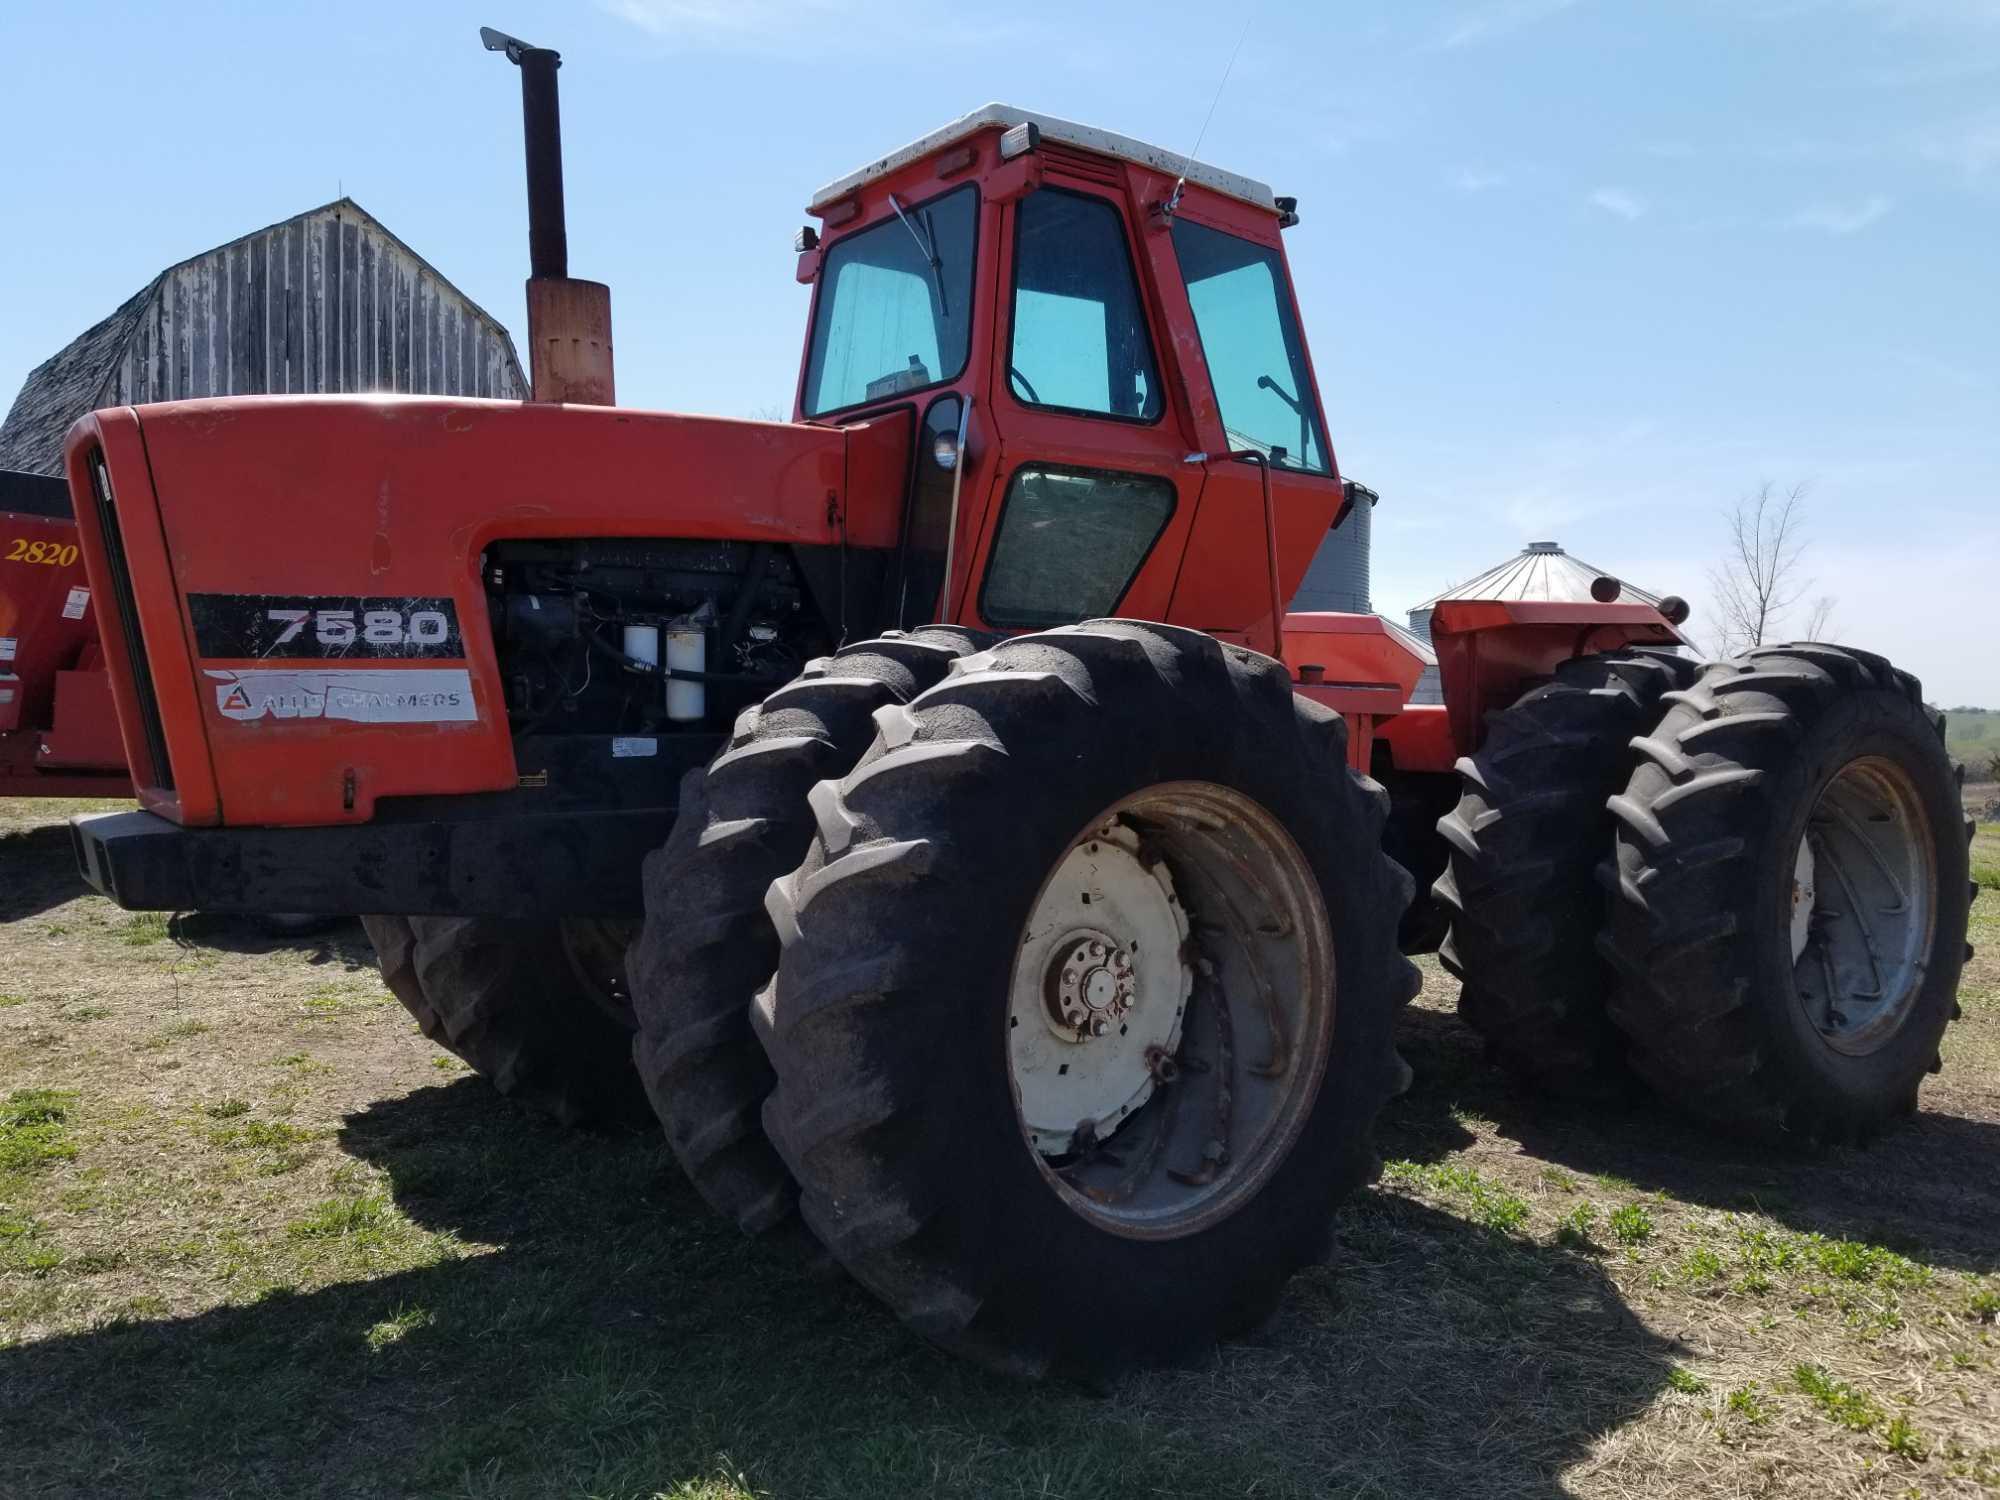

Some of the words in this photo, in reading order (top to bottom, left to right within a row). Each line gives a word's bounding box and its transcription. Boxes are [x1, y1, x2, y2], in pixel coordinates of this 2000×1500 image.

[5, 538, 79, 568] 2820
[267, 609, 448, 644] 7580
[336, 692, 461, 707] CHALMERS
